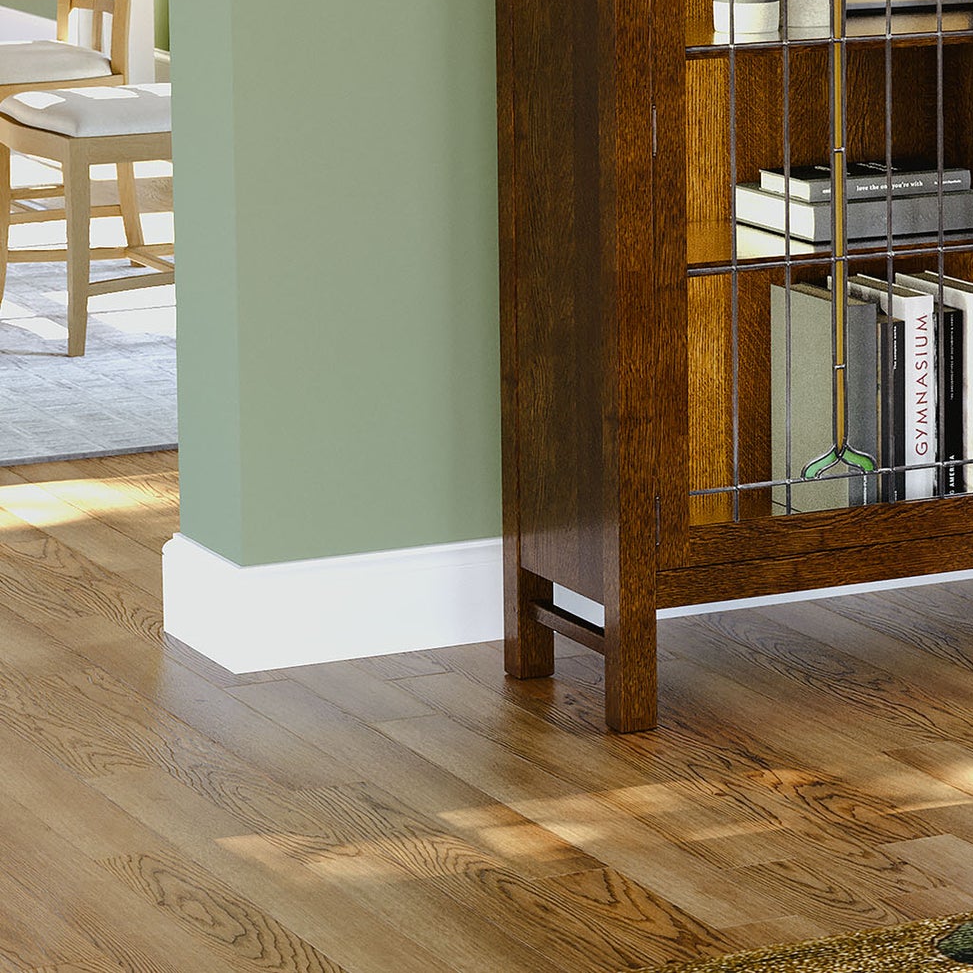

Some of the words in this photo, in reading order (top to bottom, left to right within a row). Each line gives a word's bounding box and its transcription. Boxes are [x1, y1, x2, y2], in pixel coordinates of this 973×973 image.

[856, 184, 868, 192] love
[869, 183, 879, 191] the
[891, 181, 910, 191] you're
[911, 180, 923, 188] with
[915, 314, 929, 456] GYMNASIUM
